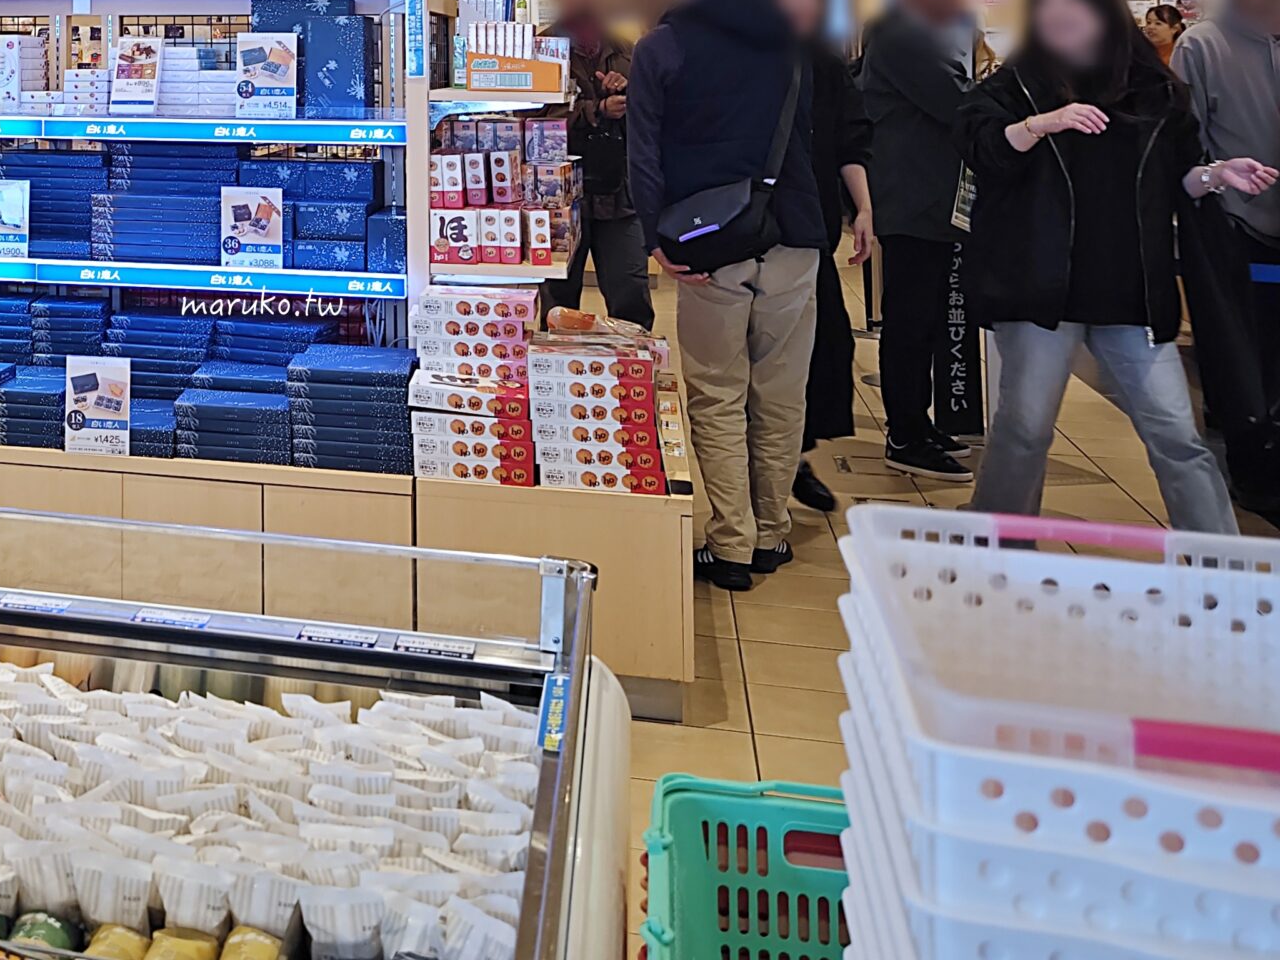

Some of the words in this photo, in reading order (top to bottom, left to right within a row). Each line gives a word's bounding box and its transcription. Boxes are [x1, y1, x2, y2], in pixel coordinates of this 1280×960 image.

[239, 83, 253, 93] 54
[438, 215, 469, 243] ほ
[224, 239, 239, 249] 36
[70, 412, 83, 424] 18
